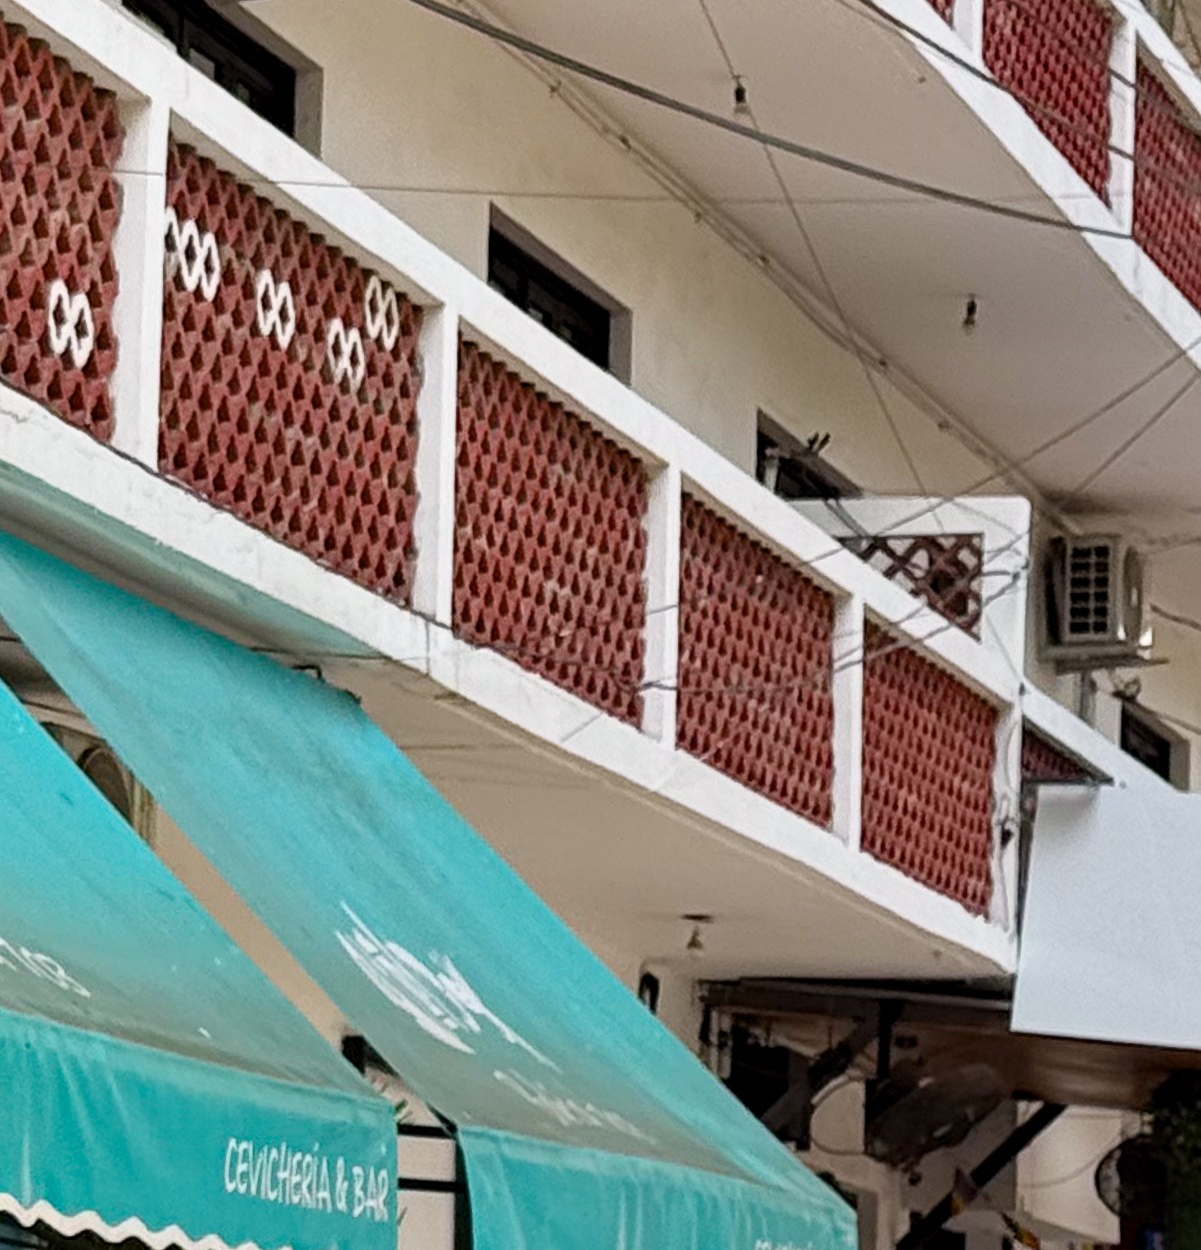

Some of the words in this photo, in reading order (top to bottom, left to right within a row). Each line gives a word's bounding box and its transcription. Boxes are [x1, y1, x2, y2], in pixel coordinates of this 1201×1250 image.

[224, 1137, 332, 1214] CEVICHERÍA
[335, 1156, 349, 1214] &
[352, 1165, 389, 1222] BAR
